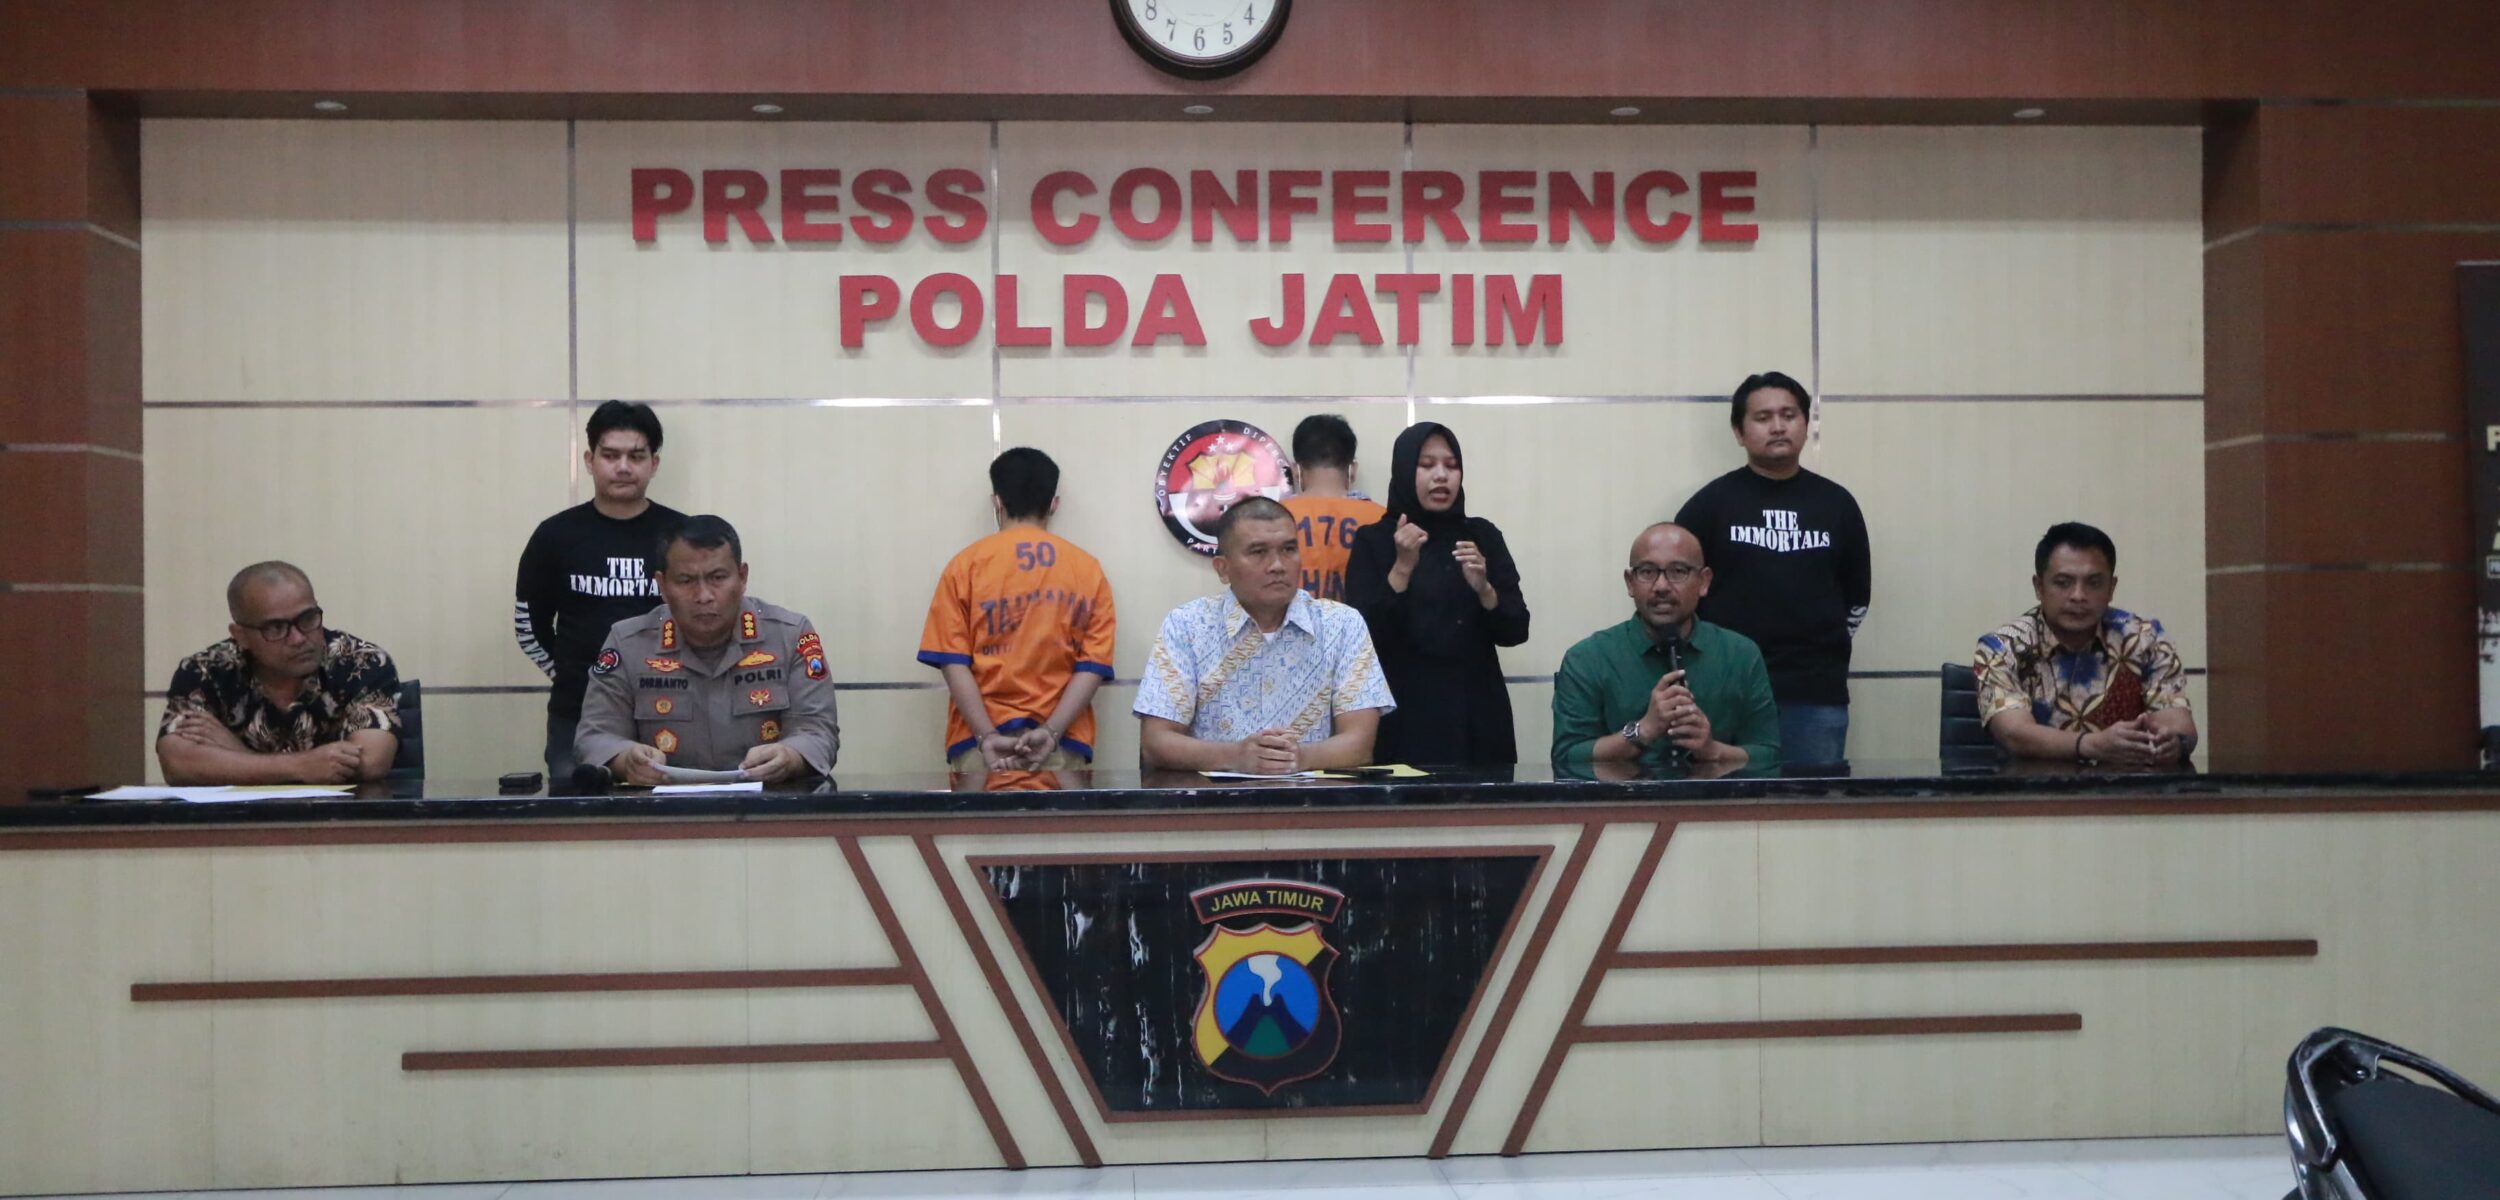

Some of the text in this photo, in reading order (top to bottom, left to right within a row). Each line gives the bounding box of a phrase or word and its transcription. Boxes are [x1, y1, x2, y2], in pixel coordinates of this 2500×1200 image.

[1145, 0, 1157, 20] 8
[1243, 3, 1254, 25] 4
[1167, 18, 1177, 41] 7
[1194, 27, 1205, 51] 6
[1223, 22, 1233, 45] 5
[631, 167, 1759, 246] PRESS CONFERENCE
[839, 272, 1564, 348] POLDA JATIM
[1157, 433, 1192, 497] OBYEKTIF
[1762, 509, 1799, 531] THE
[1297, 515, 1358, 550] 176
[1729, 525, 1831, 552] IMMORTALS
[1015, 541, 1057, 572] 50
[1186, 537, 1218, 555] PART
[606, 557, 645, 579] THE
[569, 574, 663, 597] IMMORTA
[735, 669, 782, 686] POLRI
[1211, 890, 1325, 912] JAWA TIMUR
